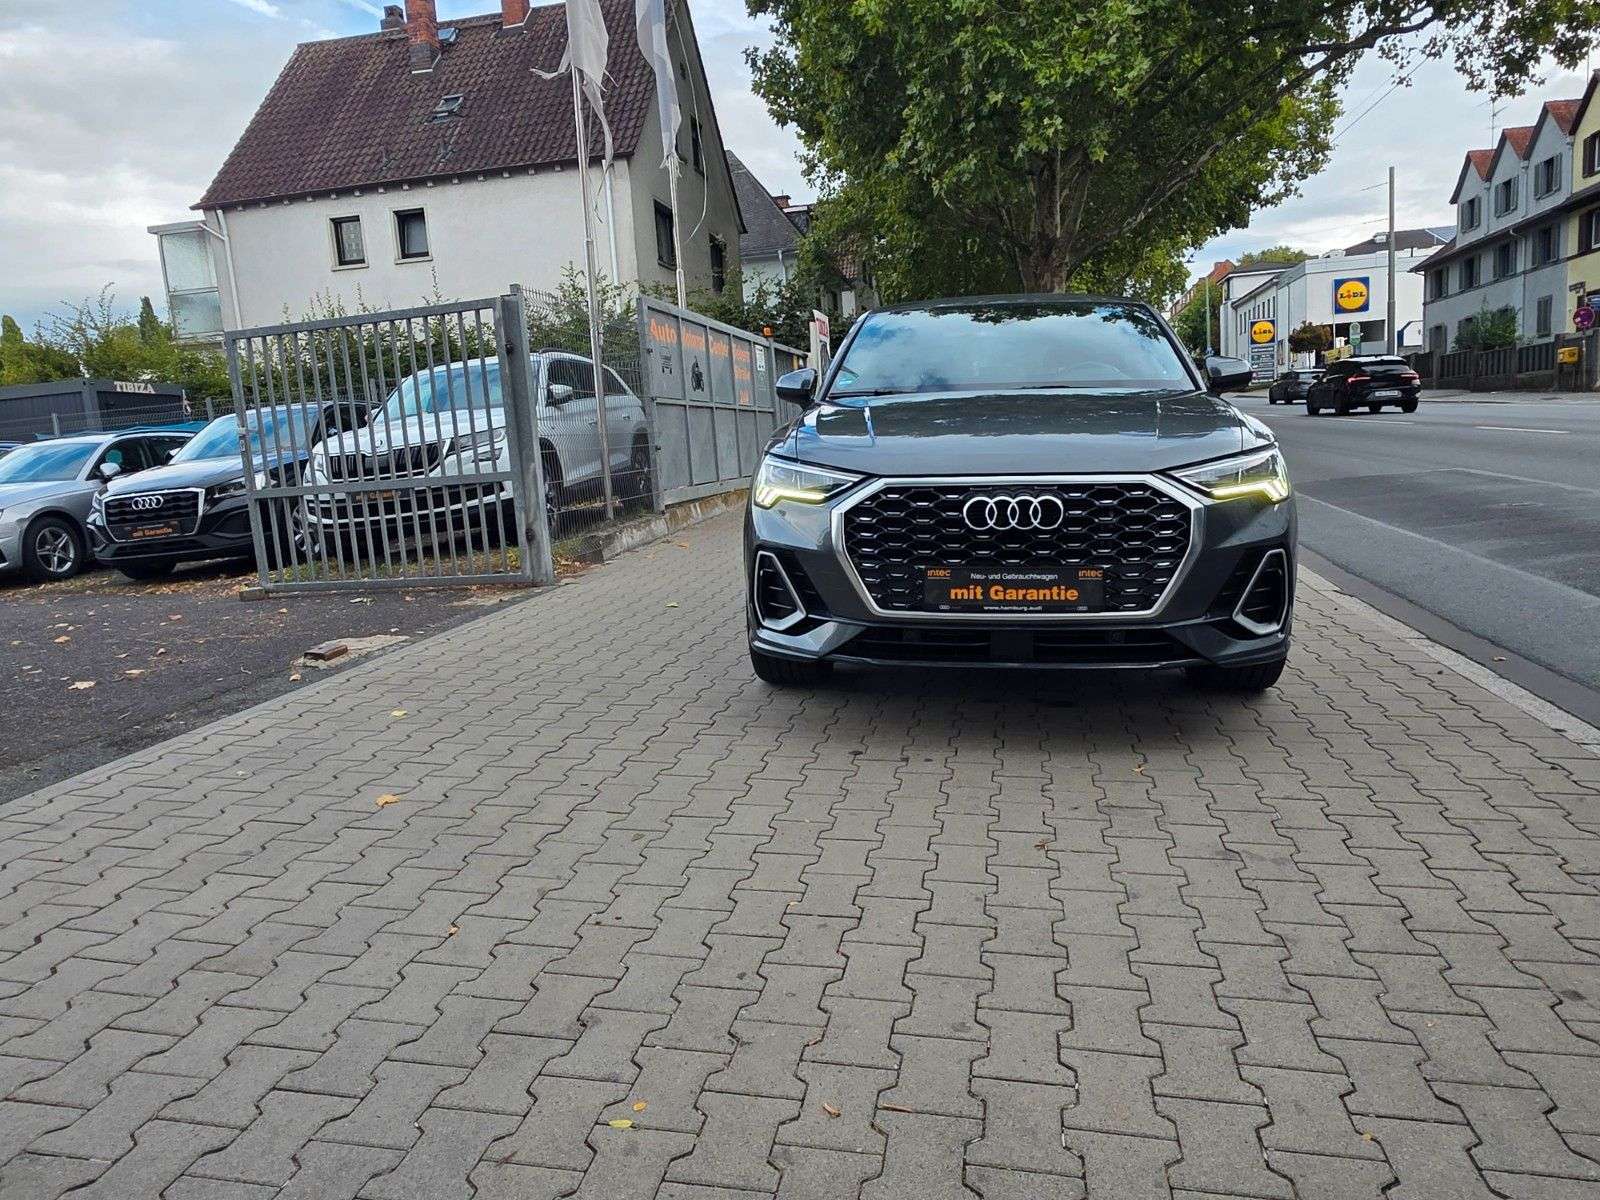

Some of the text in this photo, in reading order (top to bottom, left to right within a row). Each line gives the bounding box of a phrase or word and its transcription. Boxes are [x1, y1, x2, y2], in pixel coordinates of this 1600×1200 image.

[1339, 290, 1365, 299] LIDL
[649, 319, 677, 345] Auto
[114, 381, 156, 394] TIBIZA
[1002, 573, 1058, 581] Gebrauchtwagen
[950, 585, 1079, 600] mit Garantie
